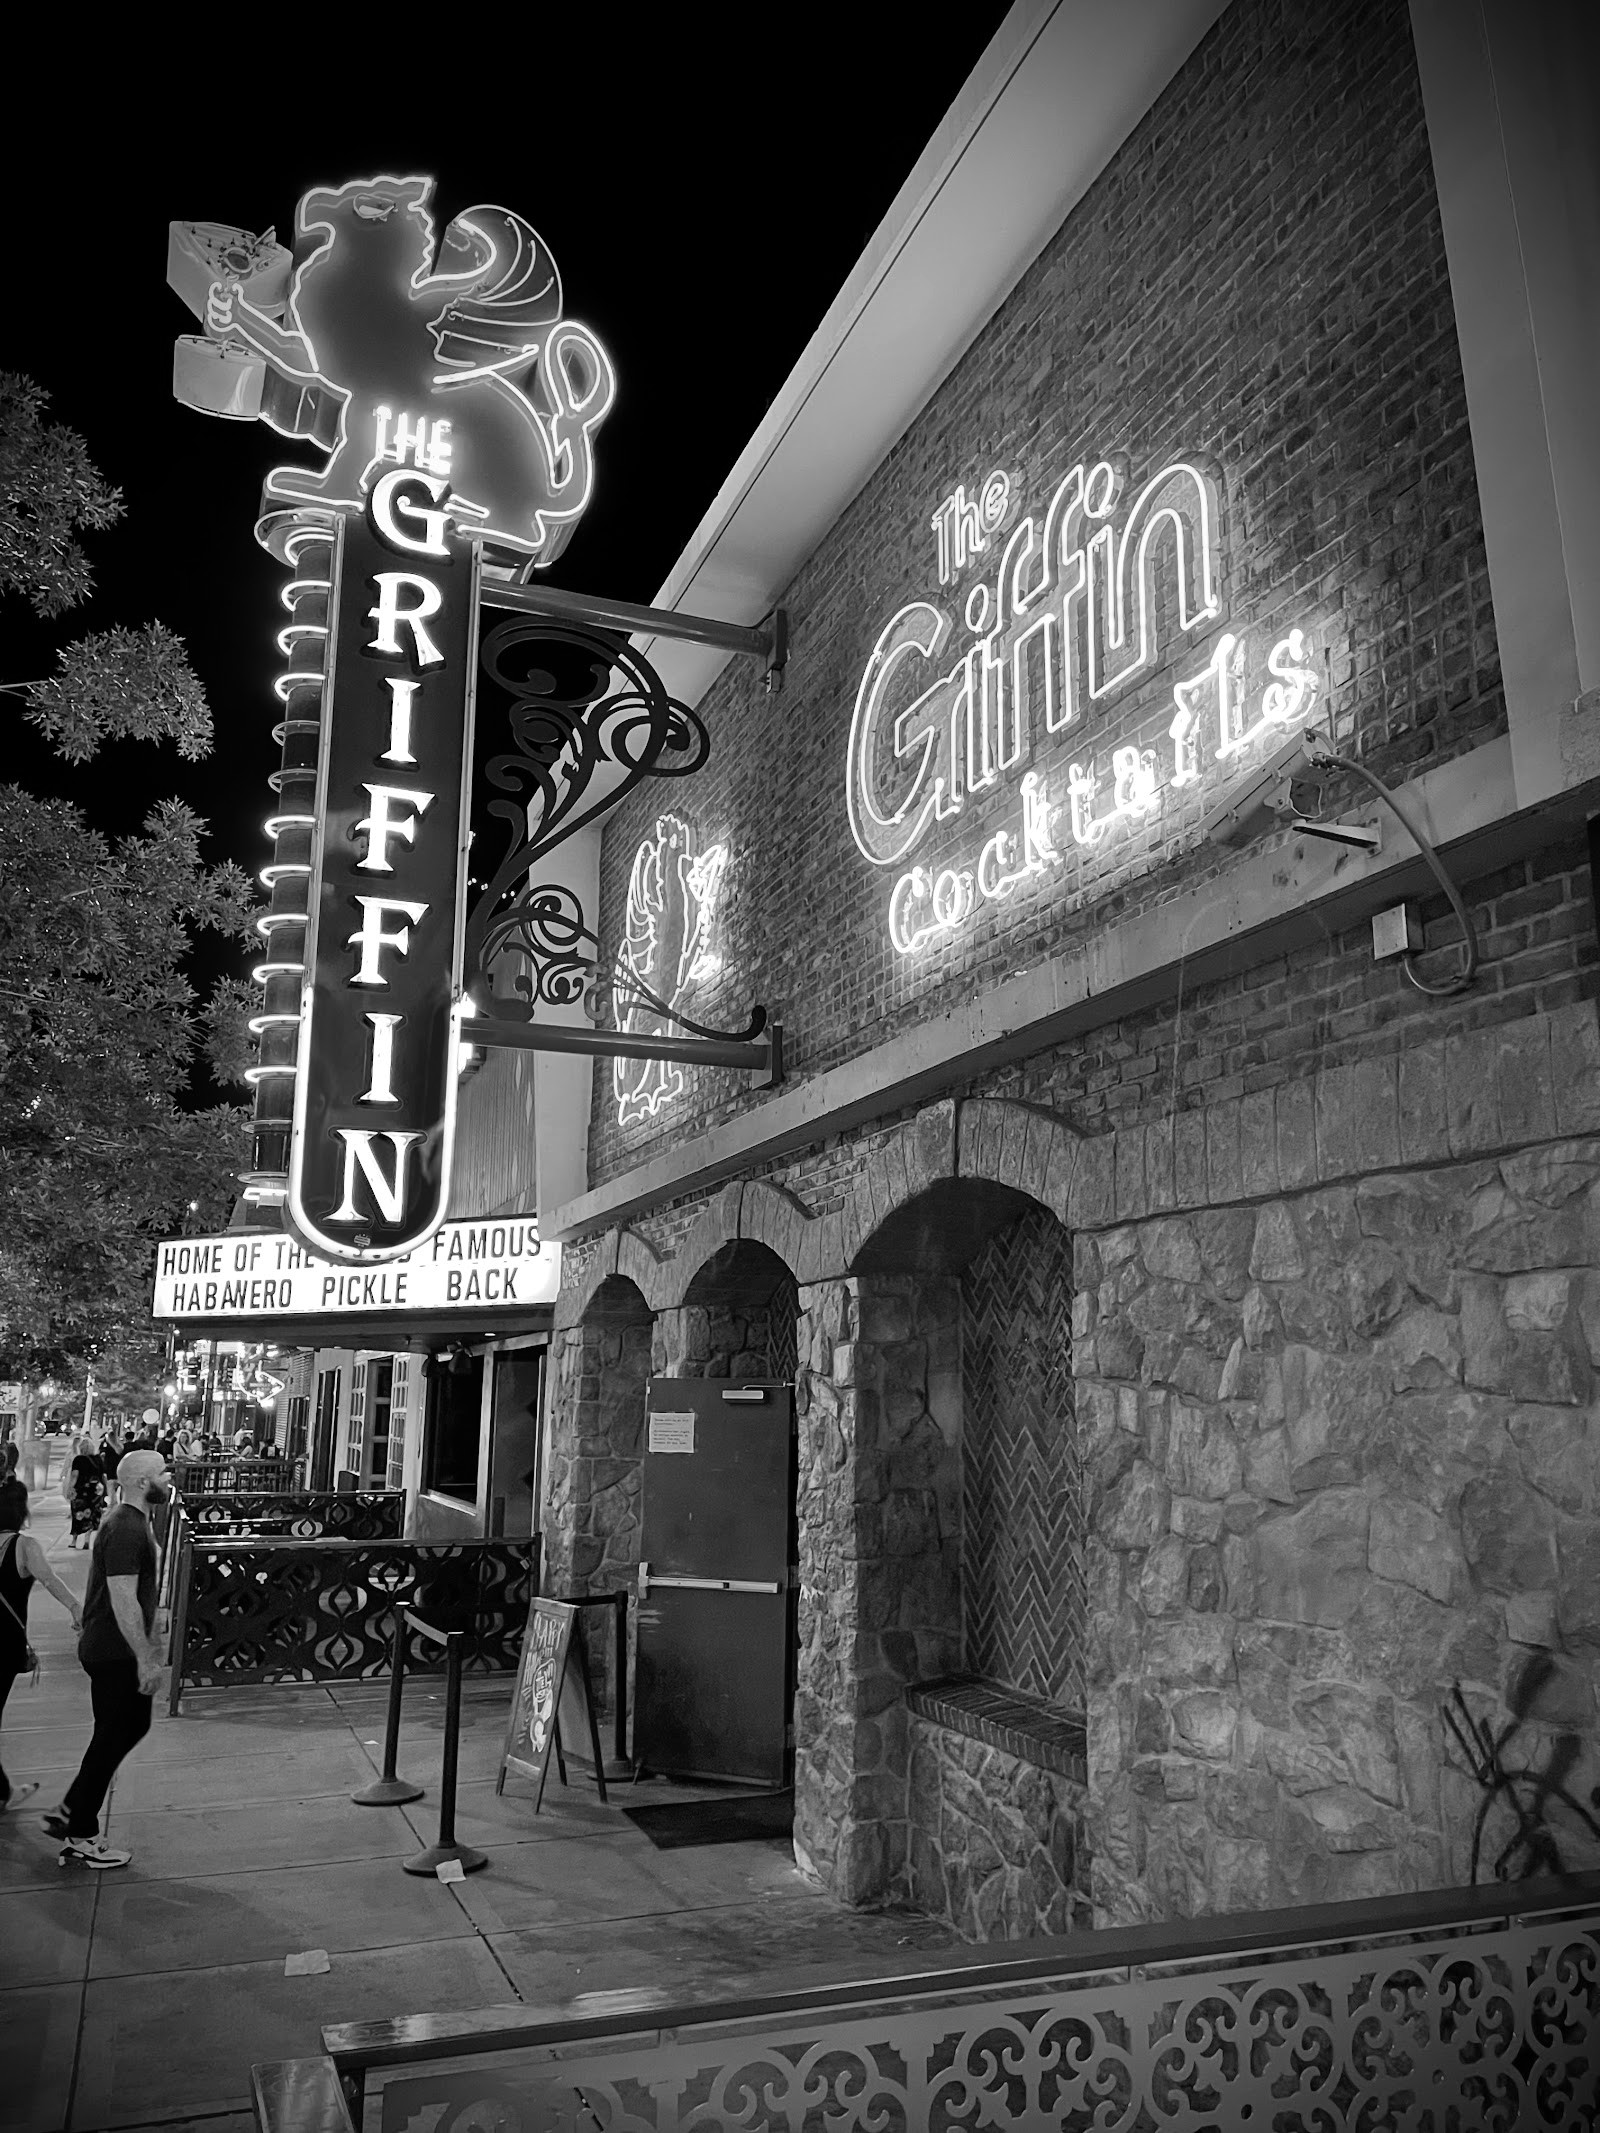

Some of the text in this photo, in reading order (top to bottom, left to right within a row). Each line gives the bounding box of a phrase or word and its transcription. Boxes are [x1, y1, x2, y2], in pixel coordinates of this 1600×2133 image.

[373, 405, 452, 475] THE
[931, 469, 1010, 584] The
[846, 462, 1217, 866] Griffin
[322, 469, 451, 1222] GRIFFIN
[163, 1245, 223, 1275] HOME
[234, 1243, 262, 1271] OF
[432, 1225, 541, 1262] FAMOUS
[172, 1267, 518, 1312] HABANERO PICKLE BACK
